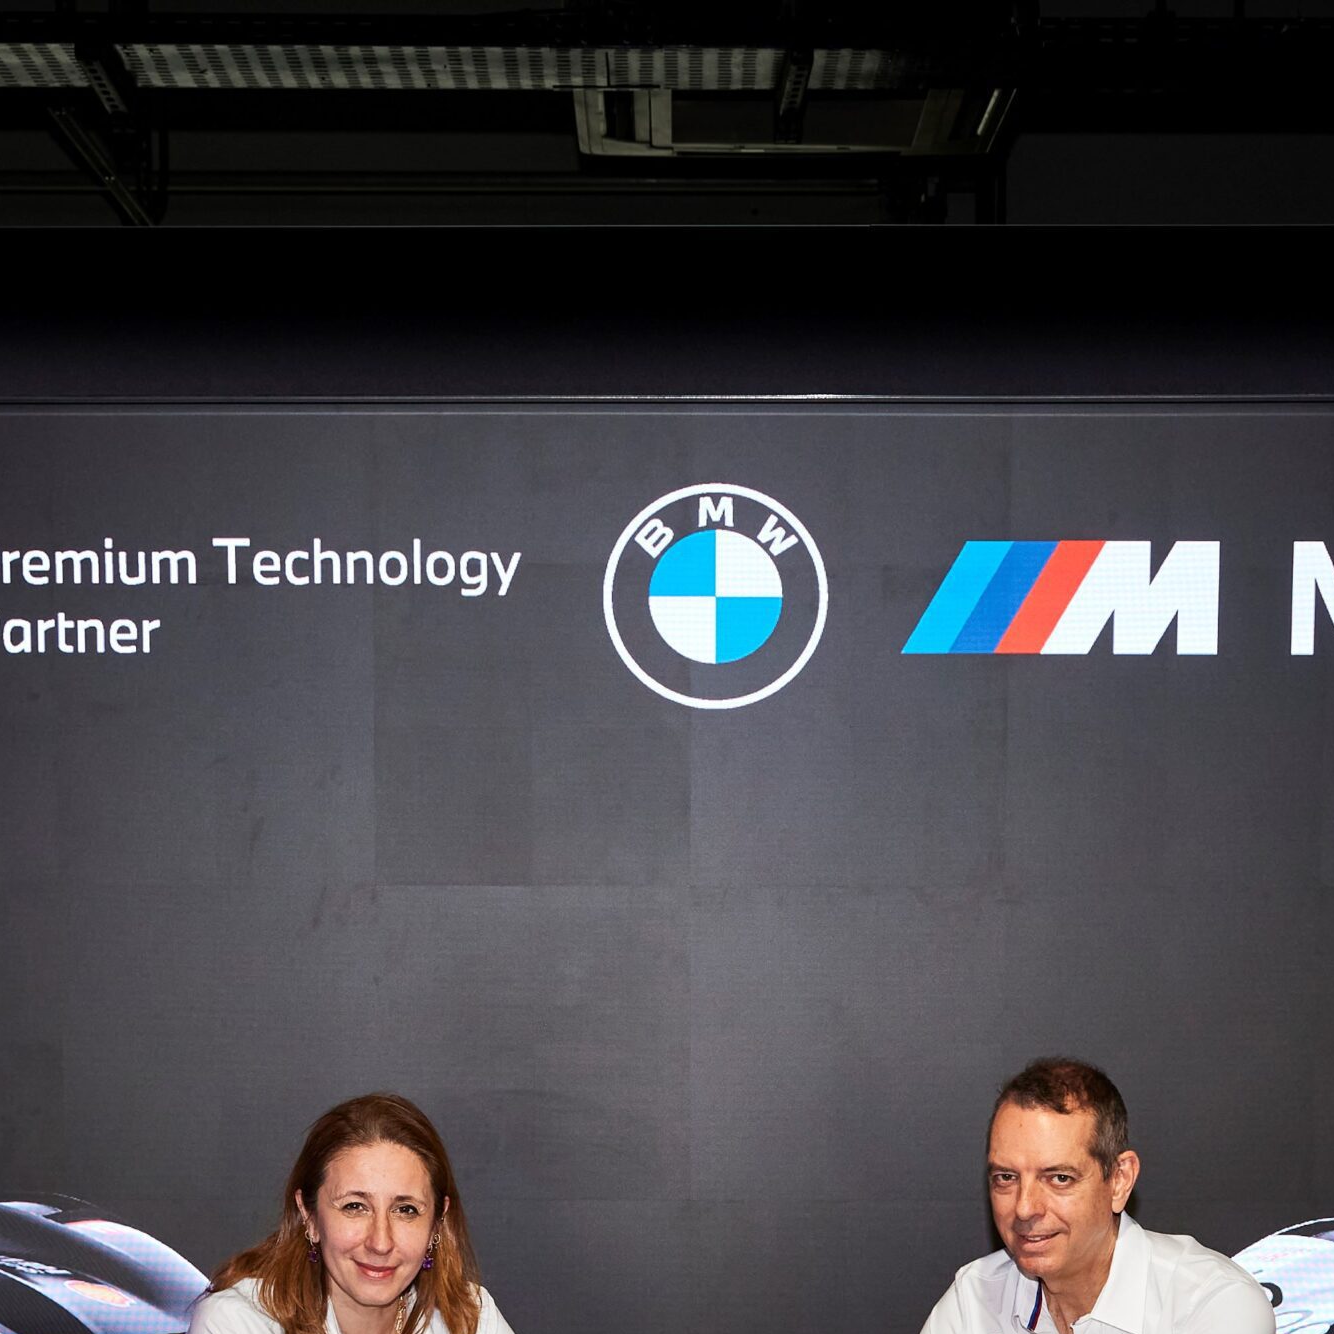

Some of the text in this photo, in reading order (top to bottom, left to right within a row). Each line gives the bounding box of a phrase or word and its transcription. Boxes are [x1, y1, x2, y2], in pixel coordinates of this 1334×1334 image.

[634, 496, 799, 558] BMW
[213, 538, 522, 597] Technology
[1040, 541, 1221, 655] M
